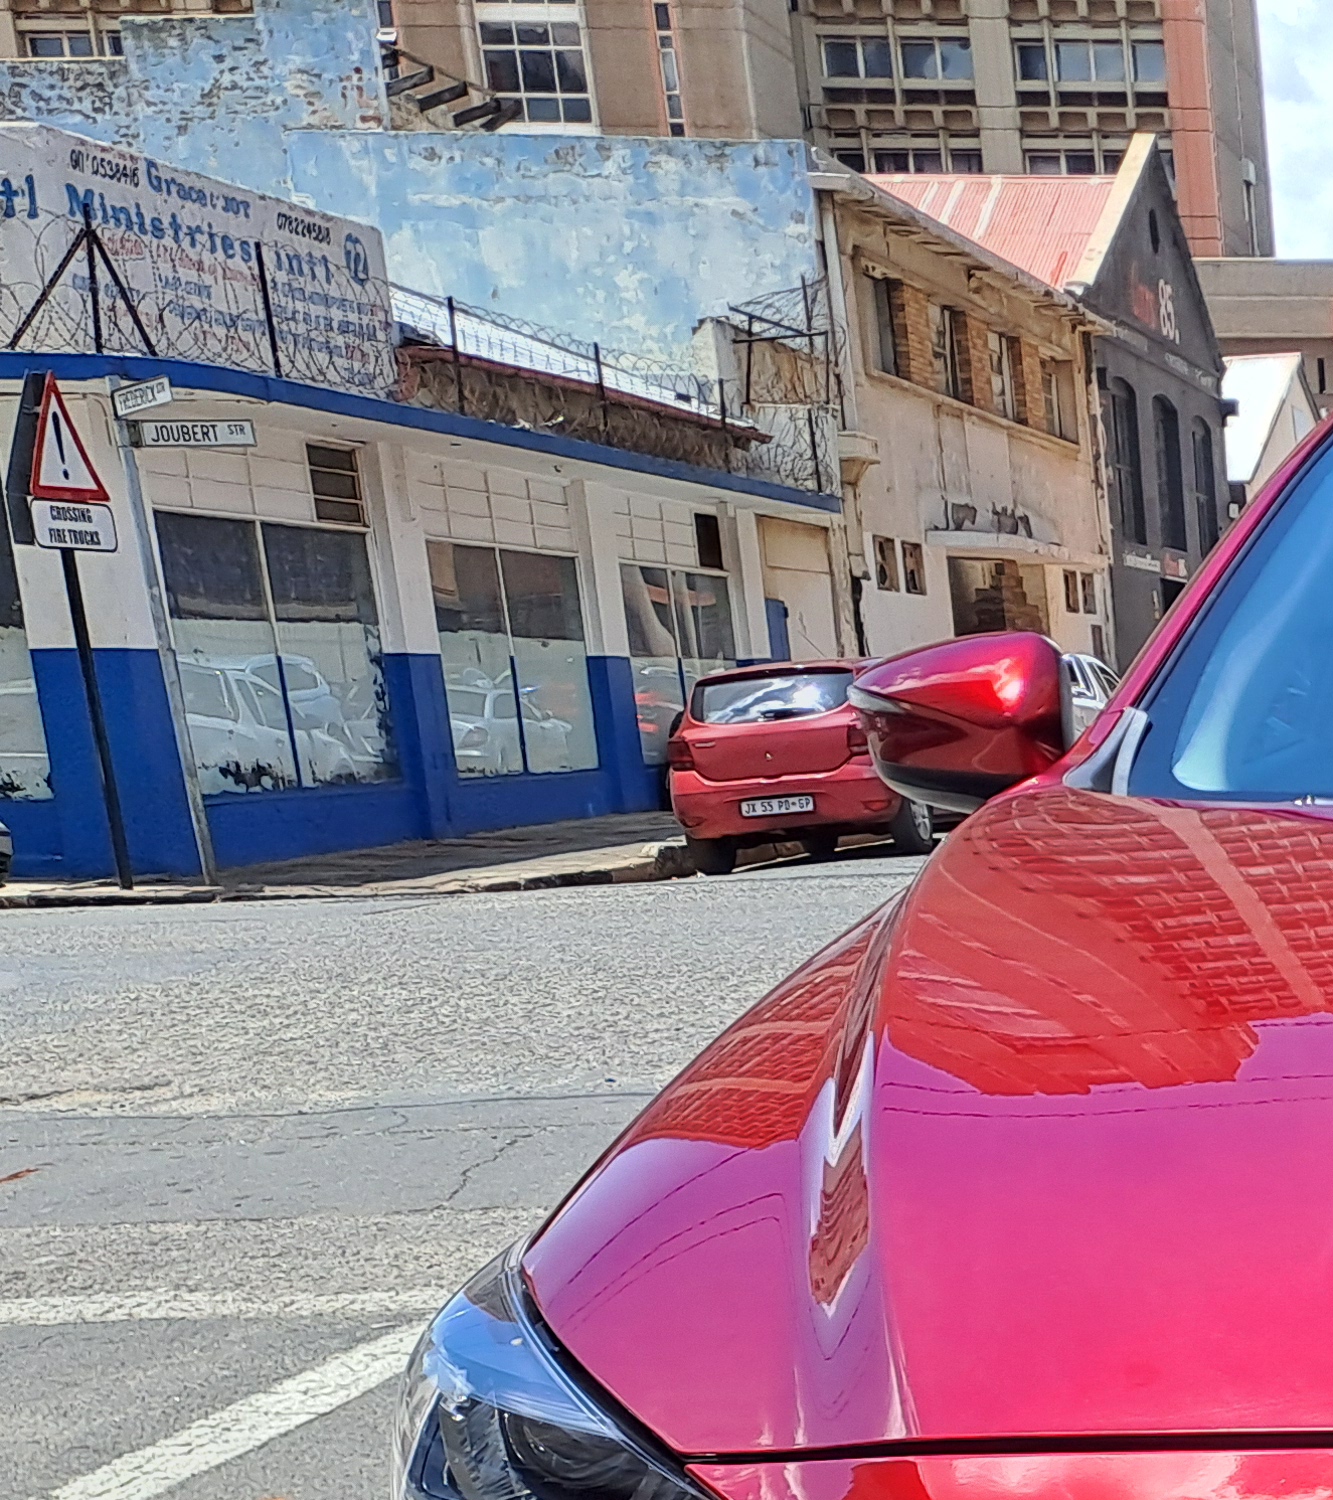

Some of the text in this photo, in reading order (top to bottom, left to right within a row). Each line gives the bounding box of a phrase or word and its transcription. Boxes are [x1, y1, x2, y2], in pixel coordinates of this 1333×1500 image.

[65, 182, 252, 263] Ministries
[151, 424, 246, 442] JOUBERT STR
[50, 504, 93, 523] CROSSING
[48, 527, 102, 546] FIRE TRUCKS
